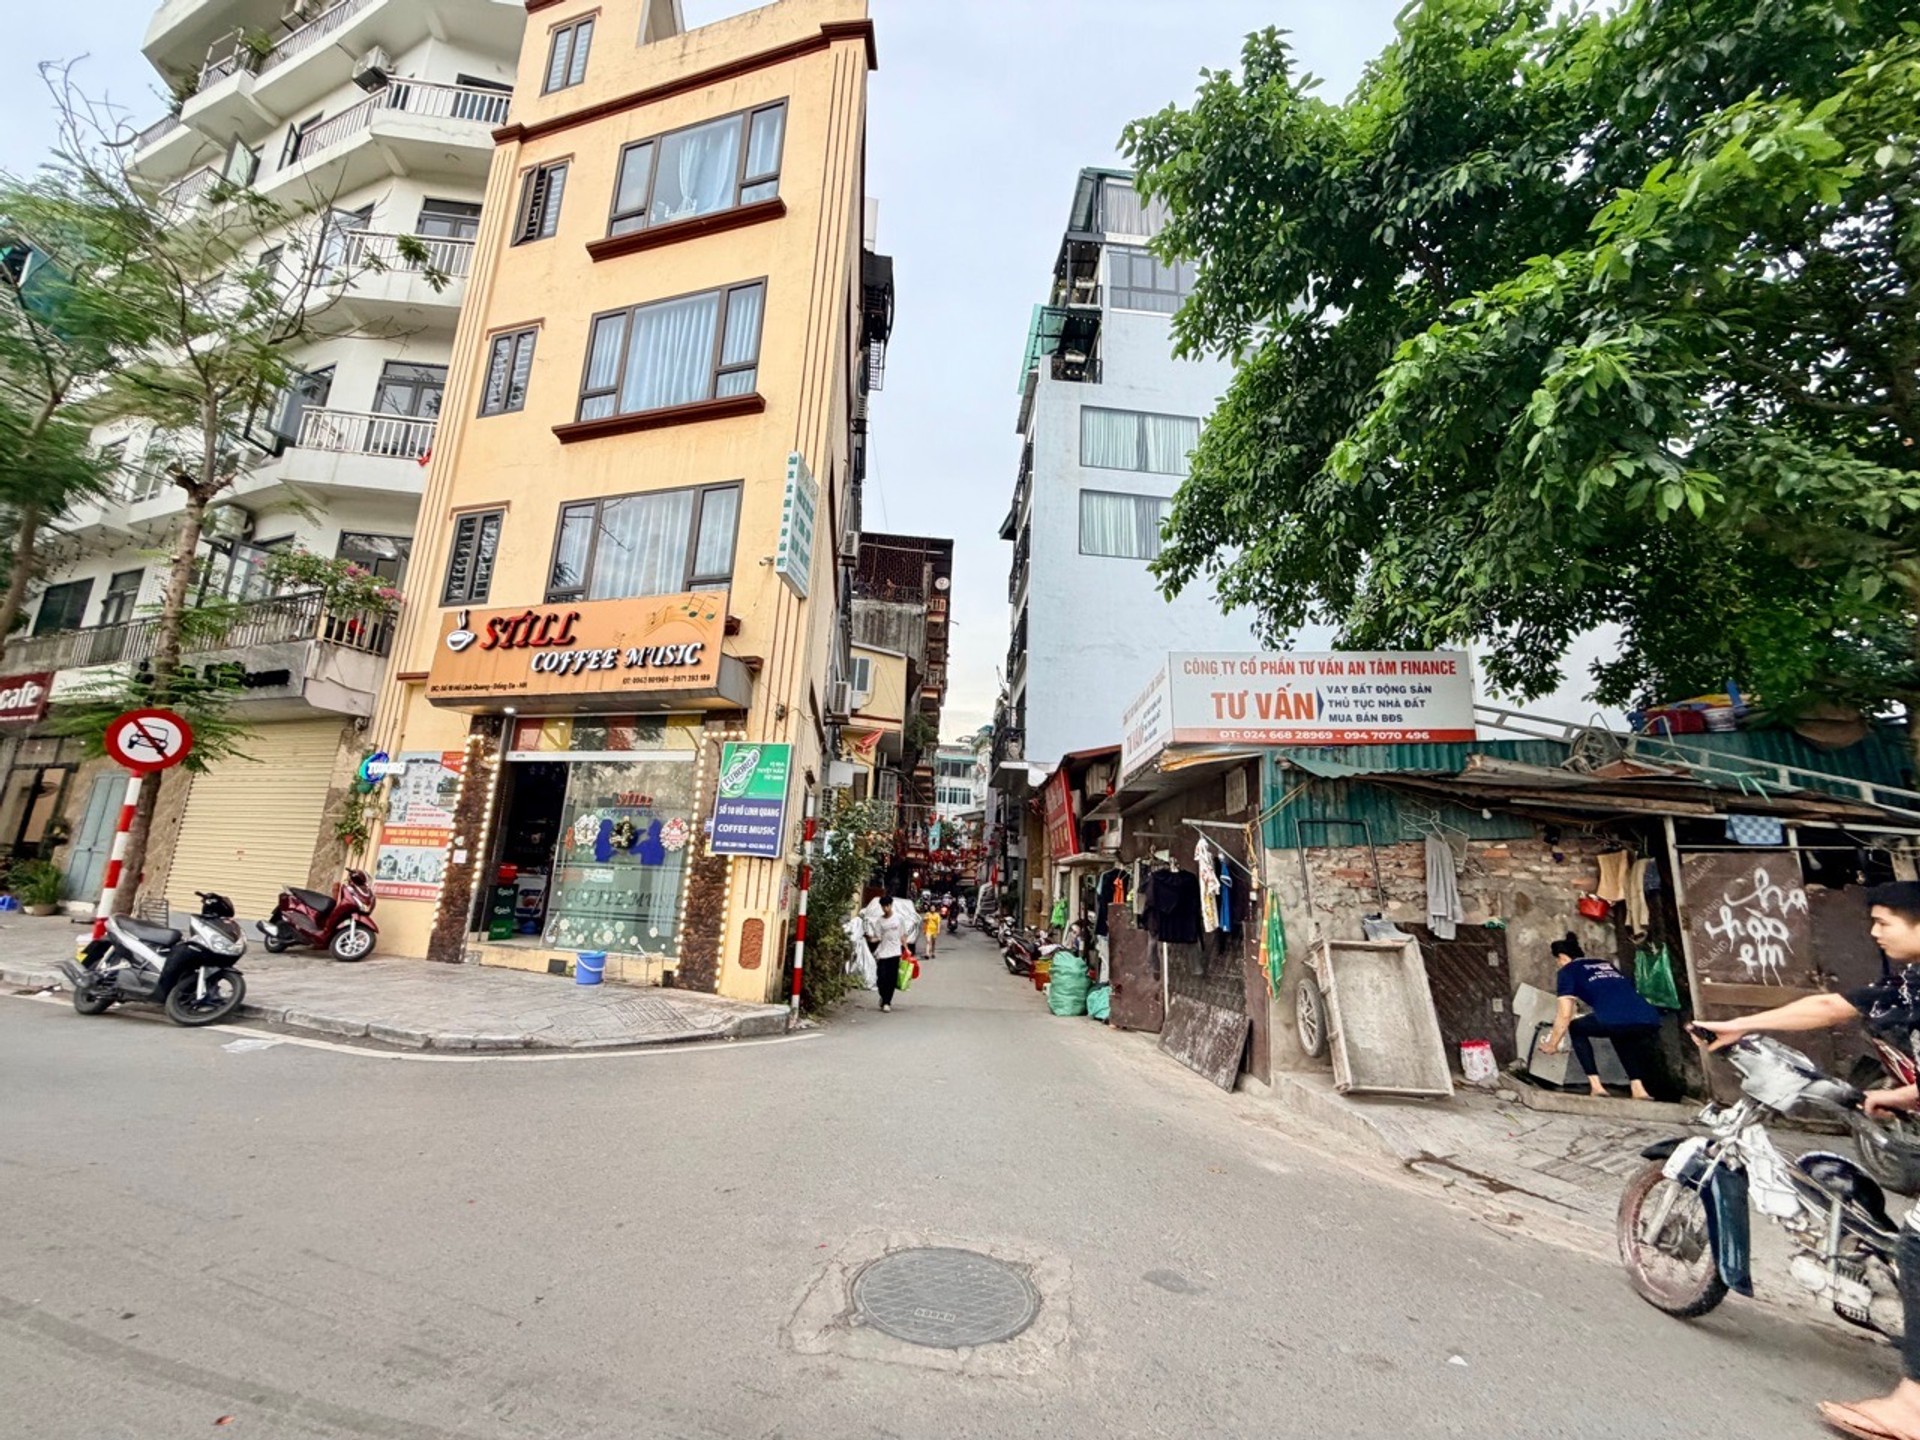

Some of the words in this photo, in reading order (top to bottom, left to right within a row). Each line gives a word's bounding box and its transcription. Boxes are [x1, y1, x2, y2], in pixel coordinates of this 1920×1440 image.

[531, 649, 618, 676] COFFEE
[624, 643, 705, 669] MUSIC
[1184, 657, 1218, 675] CÔNG
[1221, 661, 1236, 675] TY
[1260, 656, 1295, 675] PHẦN
[1298, 660, 1315, 675] TƯ
[1318, 656, 1344, 675] VẤN
[1348, 660, 1366, 675] AN
[1369, 657, 1397, 675] TÂM
[1401, 660, 1457, 675] FINANCE
[1326, 685, 1348, 694] VAY
[1351, 683, 1373, 694] BẤT
[1376, 683, 1407, 696] ĐỘNG
[1410, 682, 1432, 694] SẢN
[1211, 690, 1249, 720] TƯ
[1254, 682, 1315, 720] VẤN
[1327, 696, 1350, 708] THỦ
[1353, 699, 1375, 711] TỤC
[1378, 697, 1400, 708] NHÀ
[1404, 696, 1426, 708] ĐẤT
[1328, 714, 1353, 723] MUA
[1356, 711, 1378, 723] BÁN
[1381, 714, 1404, 723] BĐS
[1243, 731, 1266, 740] 024
[1269, 731, 1292, 740] 668
[1295, 731, 1333, 740] 28969
[1343, 731, 1369, 740] 094
[1371, 731, 1403, 740] 7070
[1405, 731, 1430, 740] 496
[717, 823, 748, 834] COFFEE
[748, 825, 776, 836] MUSIC
